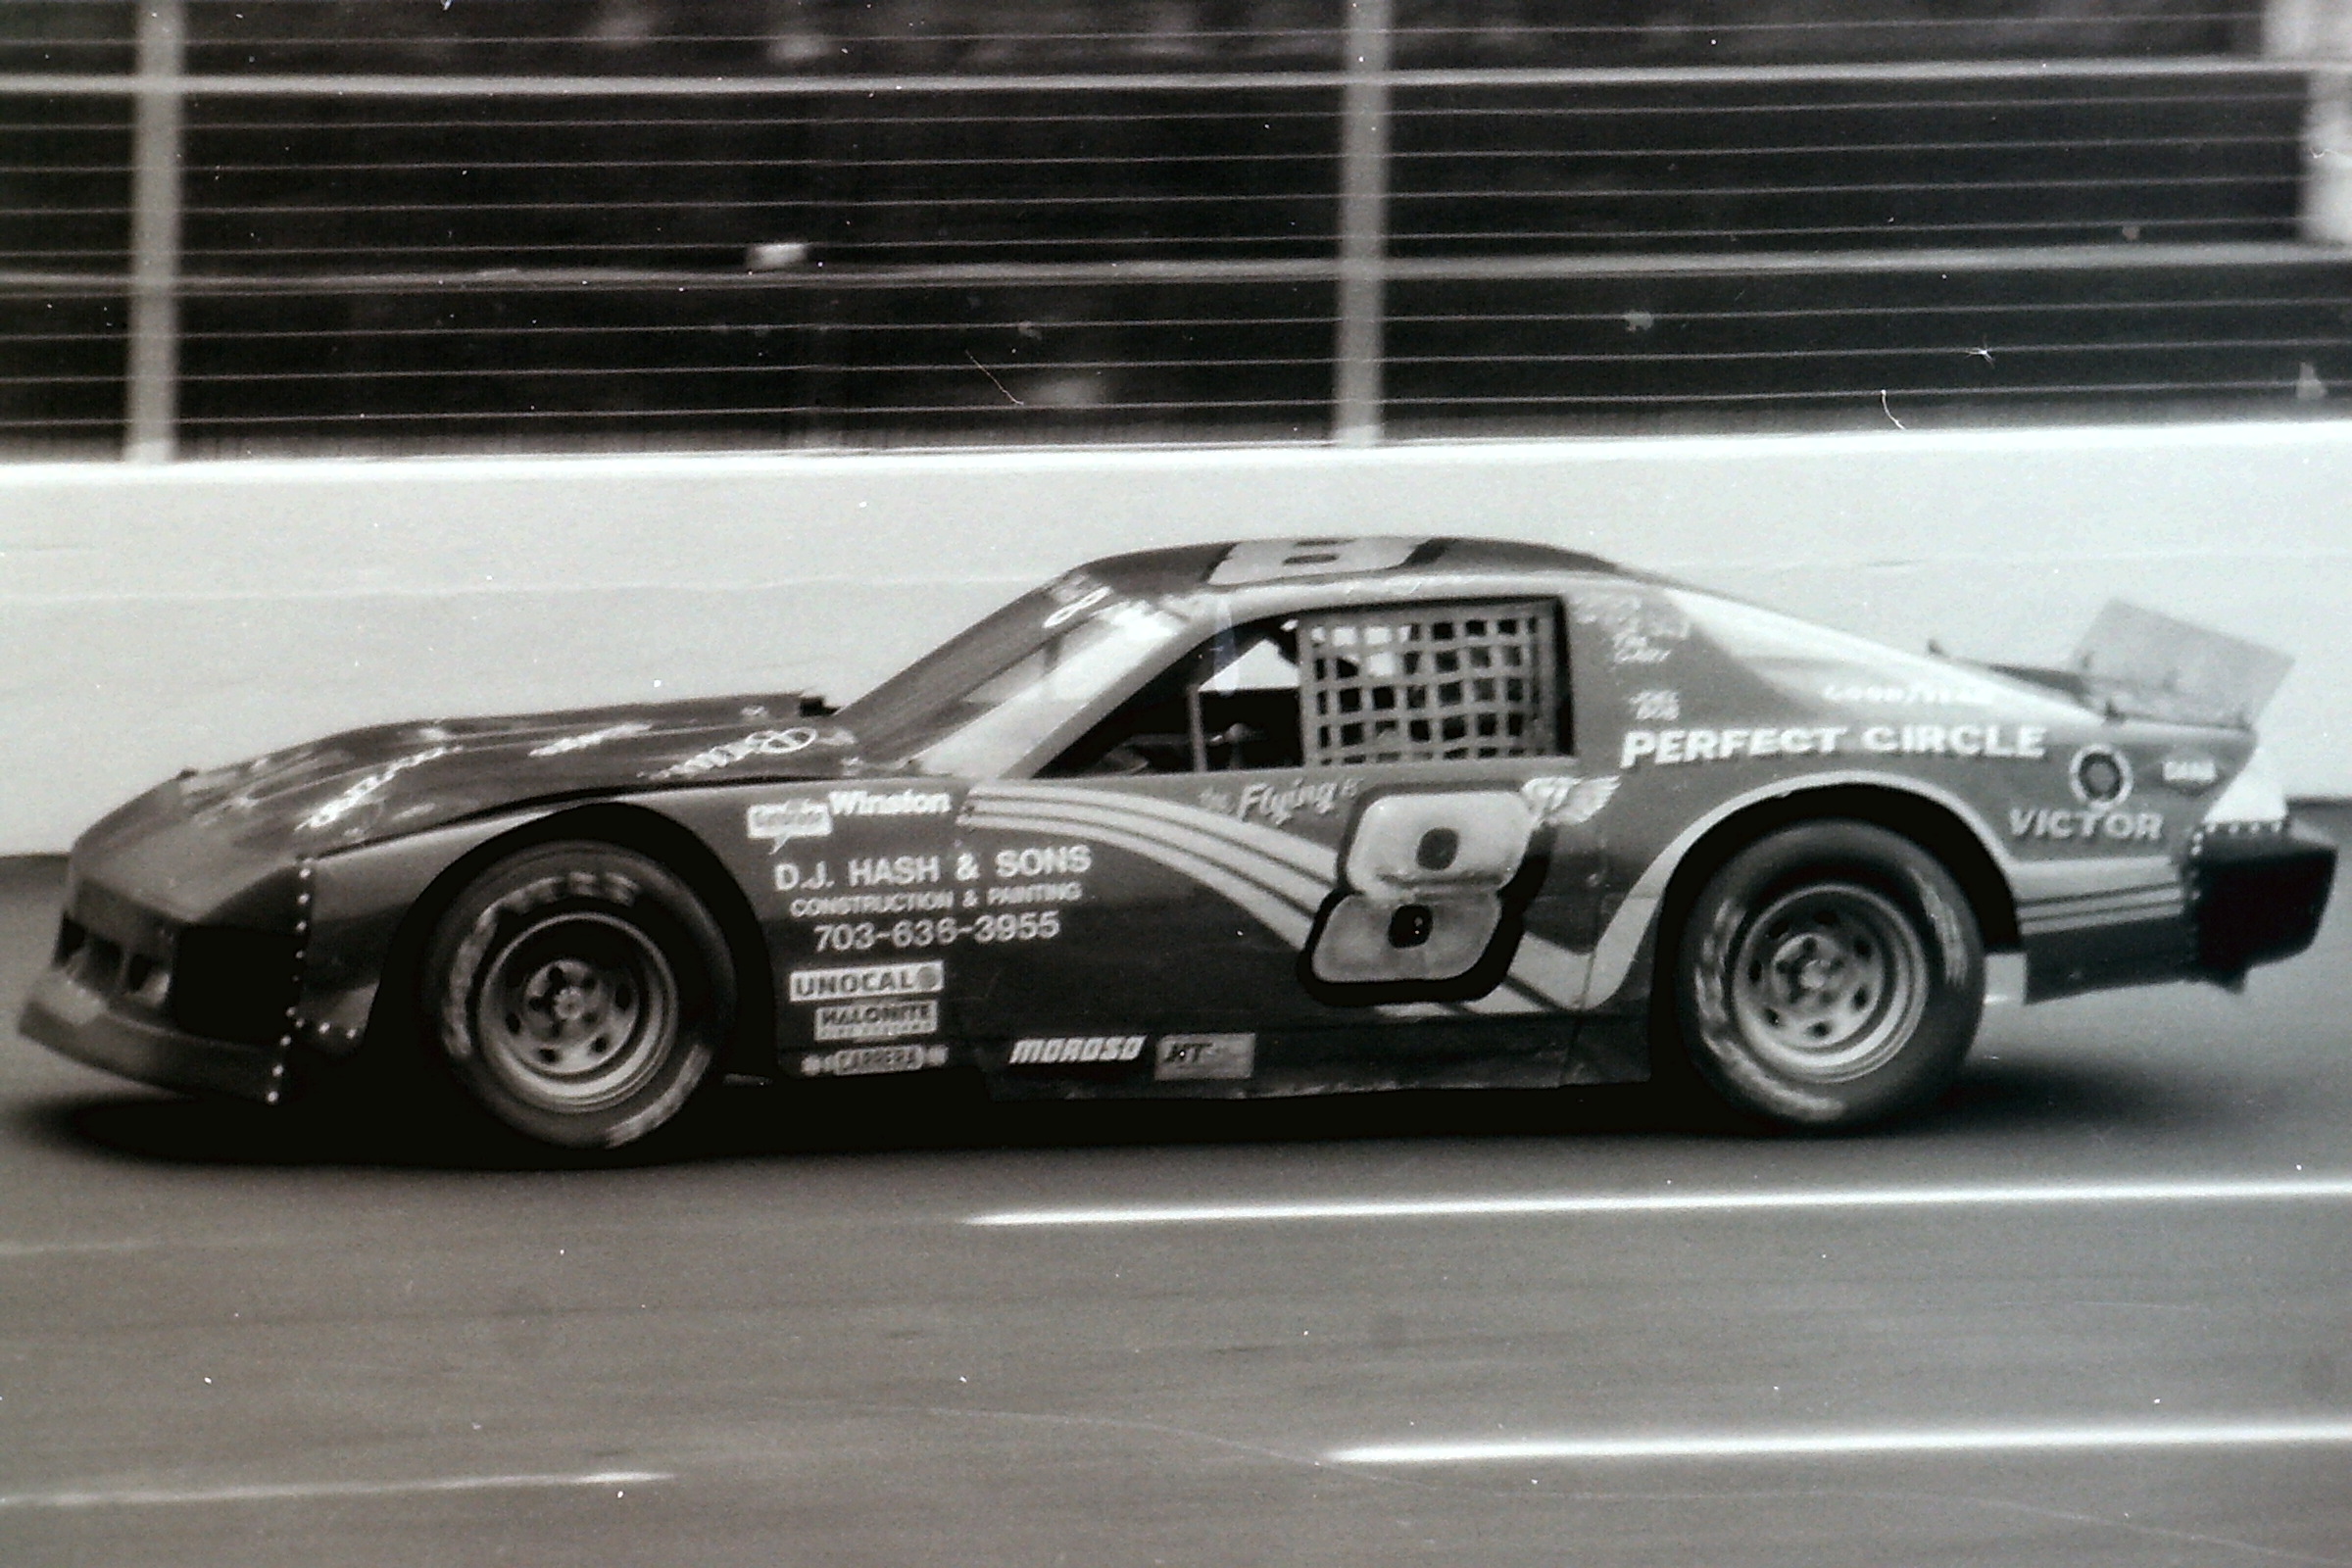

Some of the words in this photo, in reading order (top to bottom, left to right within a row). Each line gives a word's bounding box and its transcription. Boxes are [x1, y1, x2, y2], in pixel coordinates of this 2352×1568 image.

[1620, 726, 1847, 768] PERFECT
[1862, 724, 2046, 759] CIRCLE
[829, 790, 952, 815] Winston
[1236, 777, 1339, 825] Flying
[2009, 808, 2164, 840] VICTOR
[774, 860, 834, 891] D.J.
[848, 856, 940, 886] HASH
[956, 852, 979, 881] &
[995, 845, 1092, 878] SONS
[790, 891, 954, 917] CONSTRUCTION
[962, 889, 978, 907] &
[1311, 794, 1532, 983] 8
[796, 970, 913, 997] UNOCAL
[1009, 1035, 1147, 1064] MOROSO
